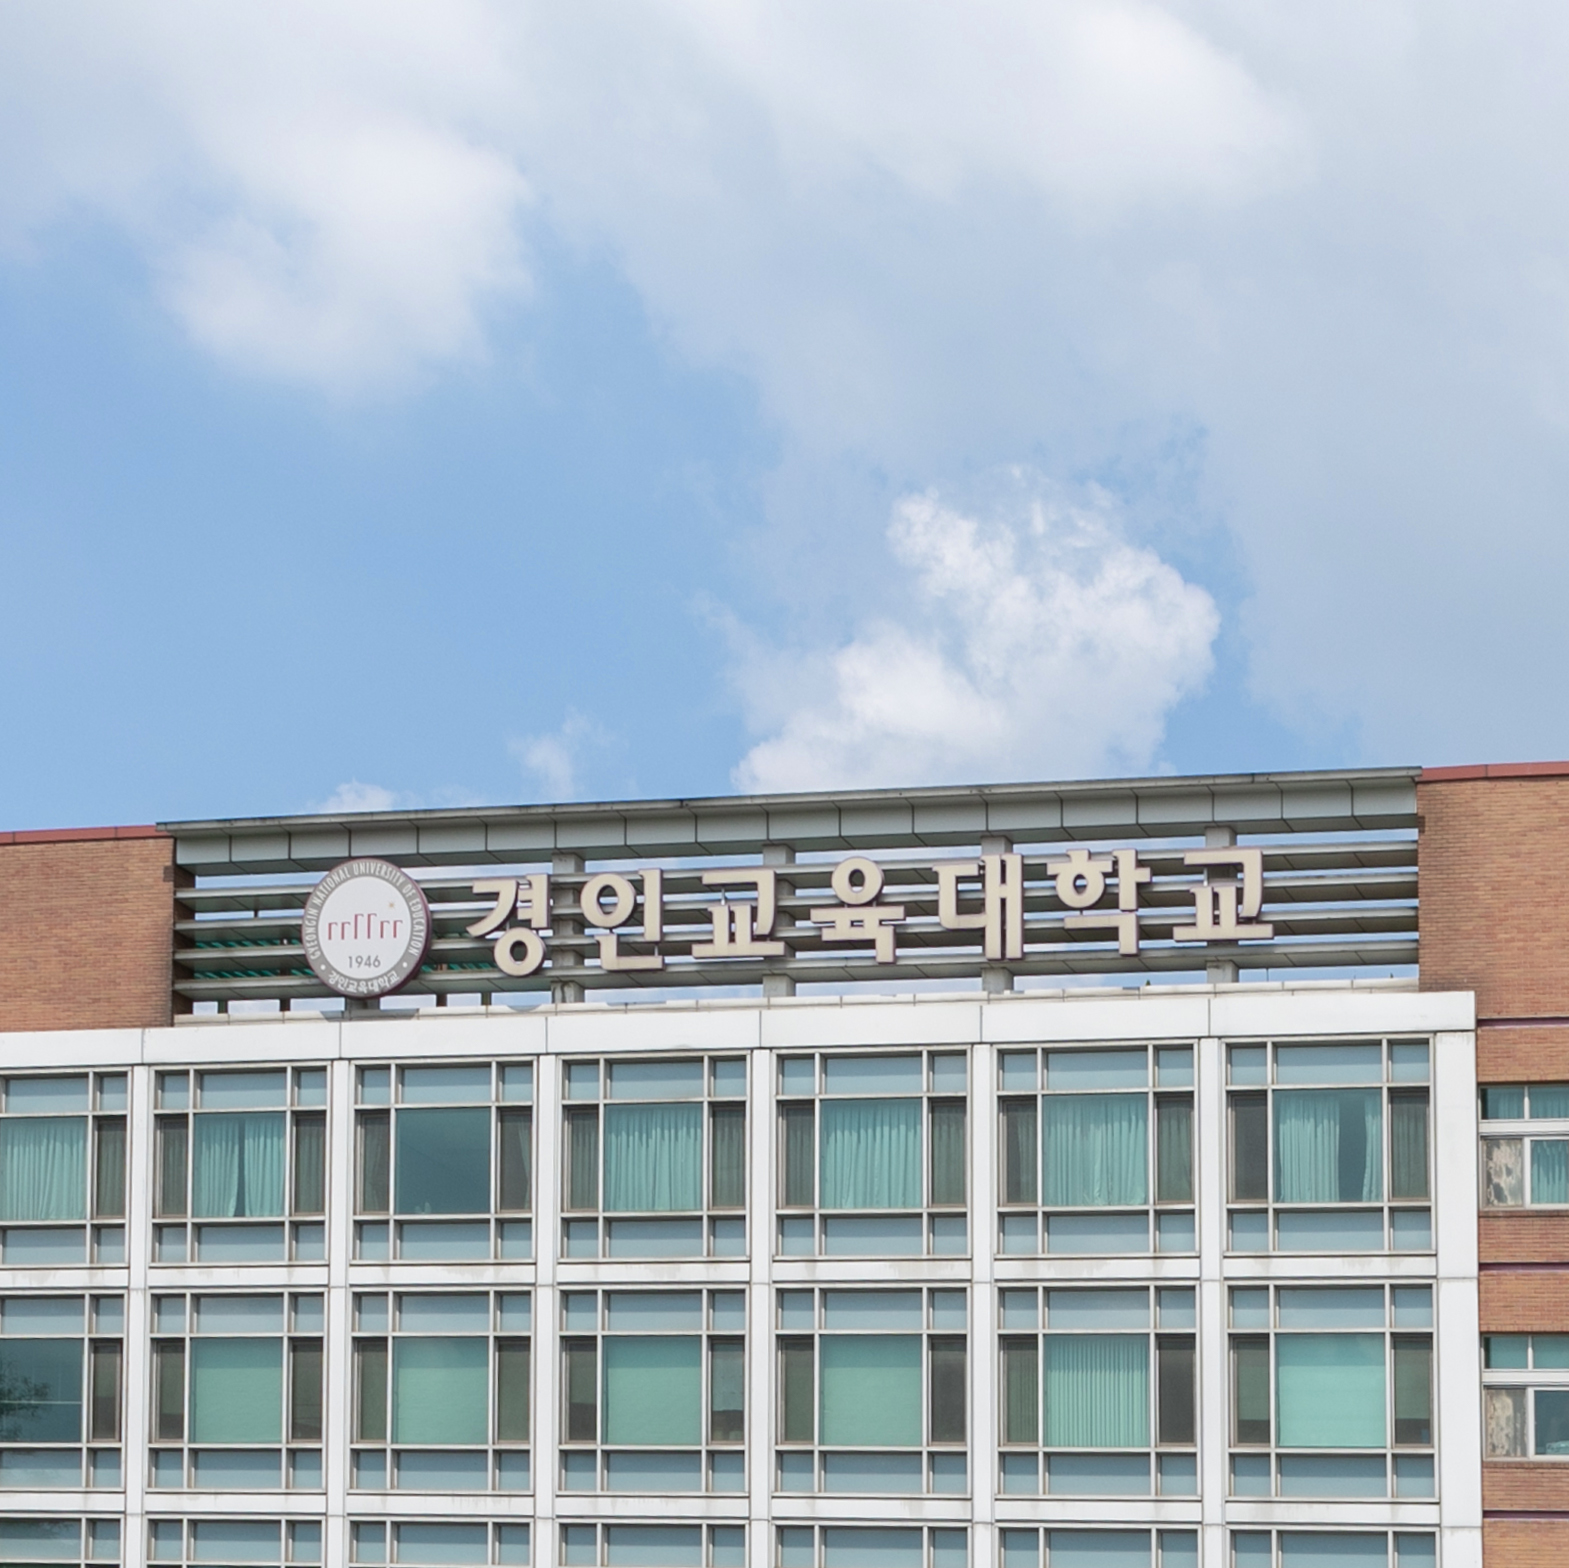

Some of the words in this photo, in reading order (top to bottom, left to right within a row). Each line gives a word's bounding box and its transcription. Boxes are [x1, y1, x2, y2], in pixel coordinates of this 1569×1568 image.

[312, 866, 351, 907] NATIONAL
[353, 861, 406, 887] UNIVERSITY
[402, 883, 417, 898] OF
[408, 898, 425, 956] EDUCATION
[465, 846, 1275, 977] 경인교육대학교
[305, 907, 321, 960] GYEONGIN
[348, 955, 381, 968] 1946
[328, 971, 400, 994] 경인교육대학교
